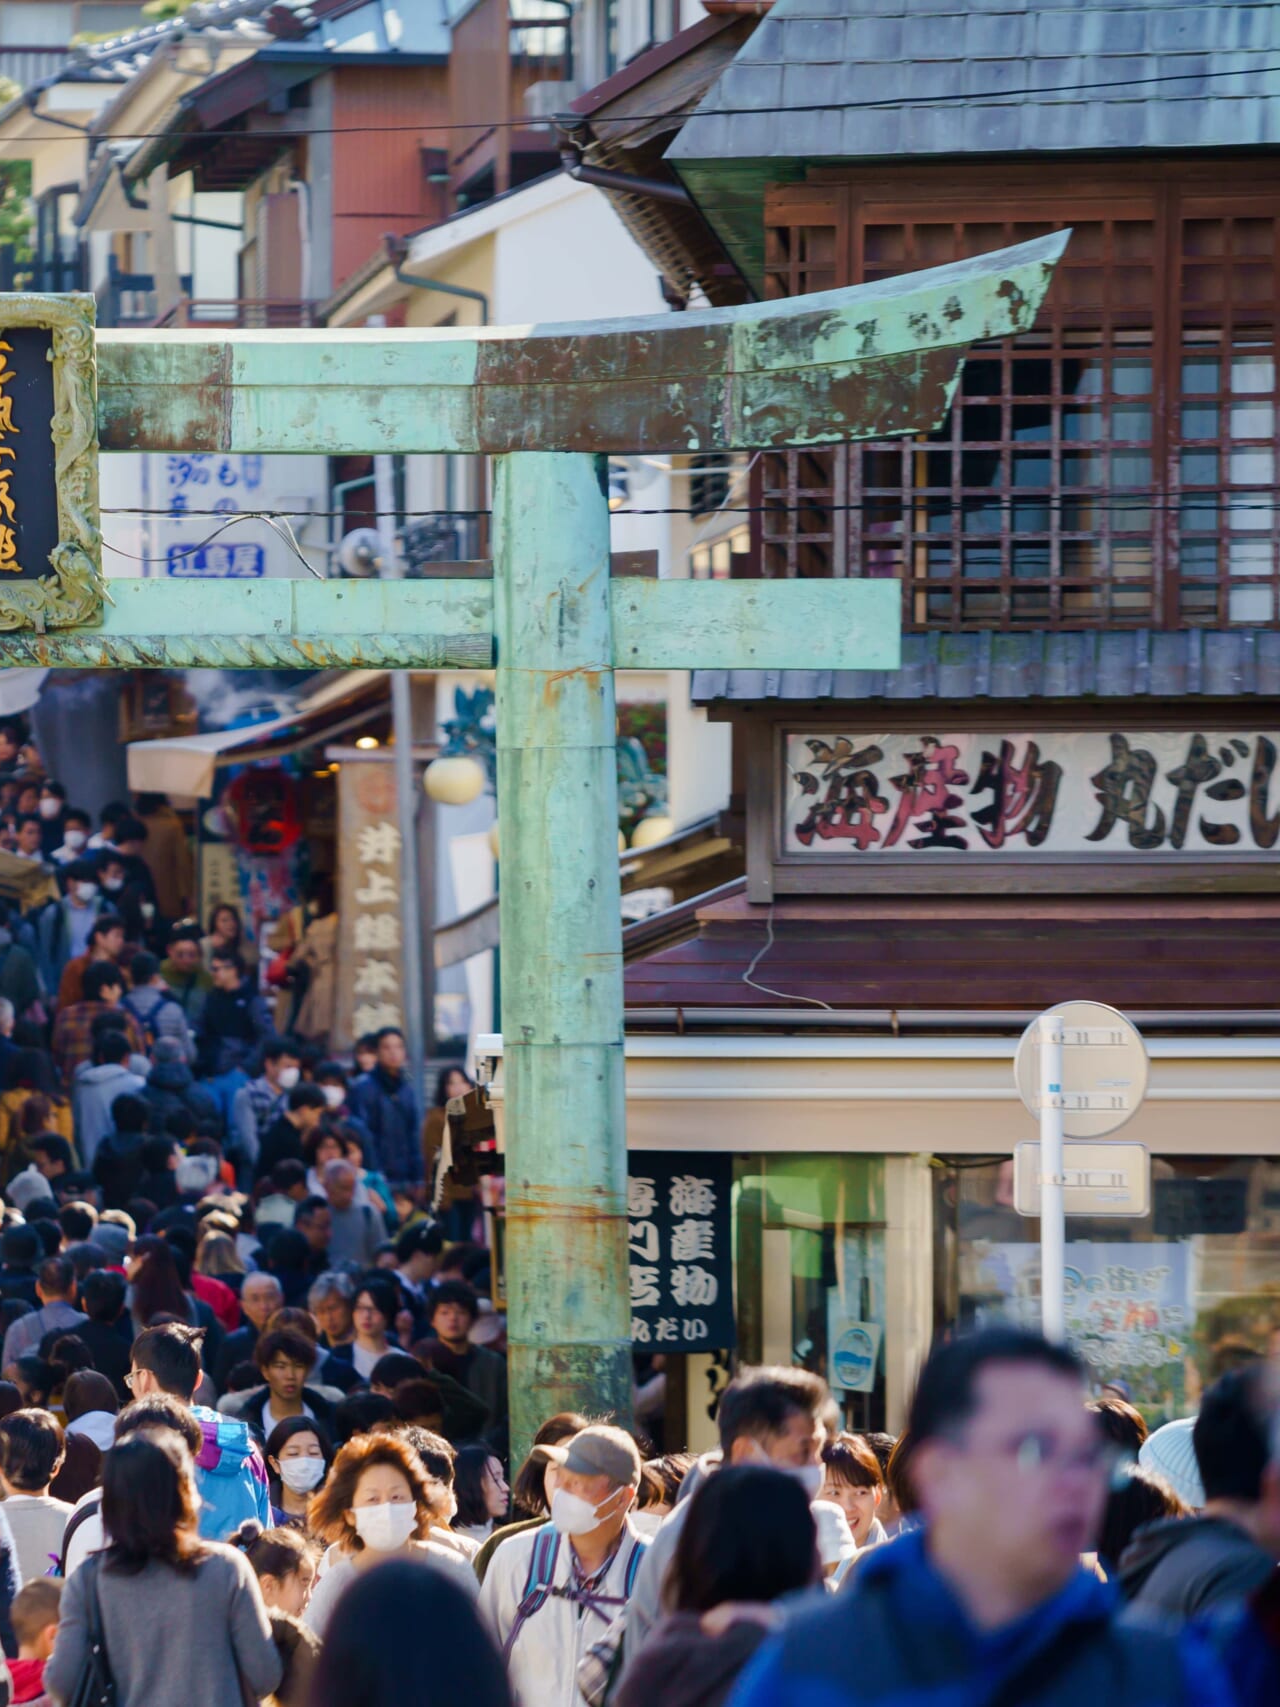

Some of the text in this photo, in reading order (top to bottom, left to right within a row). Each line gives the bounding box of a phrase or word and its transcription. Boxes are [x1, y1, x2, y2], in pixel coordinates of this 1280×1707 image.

[793, 734, 1064, 850] 海産物
[669, 1175, 719, 1307] 海産物
